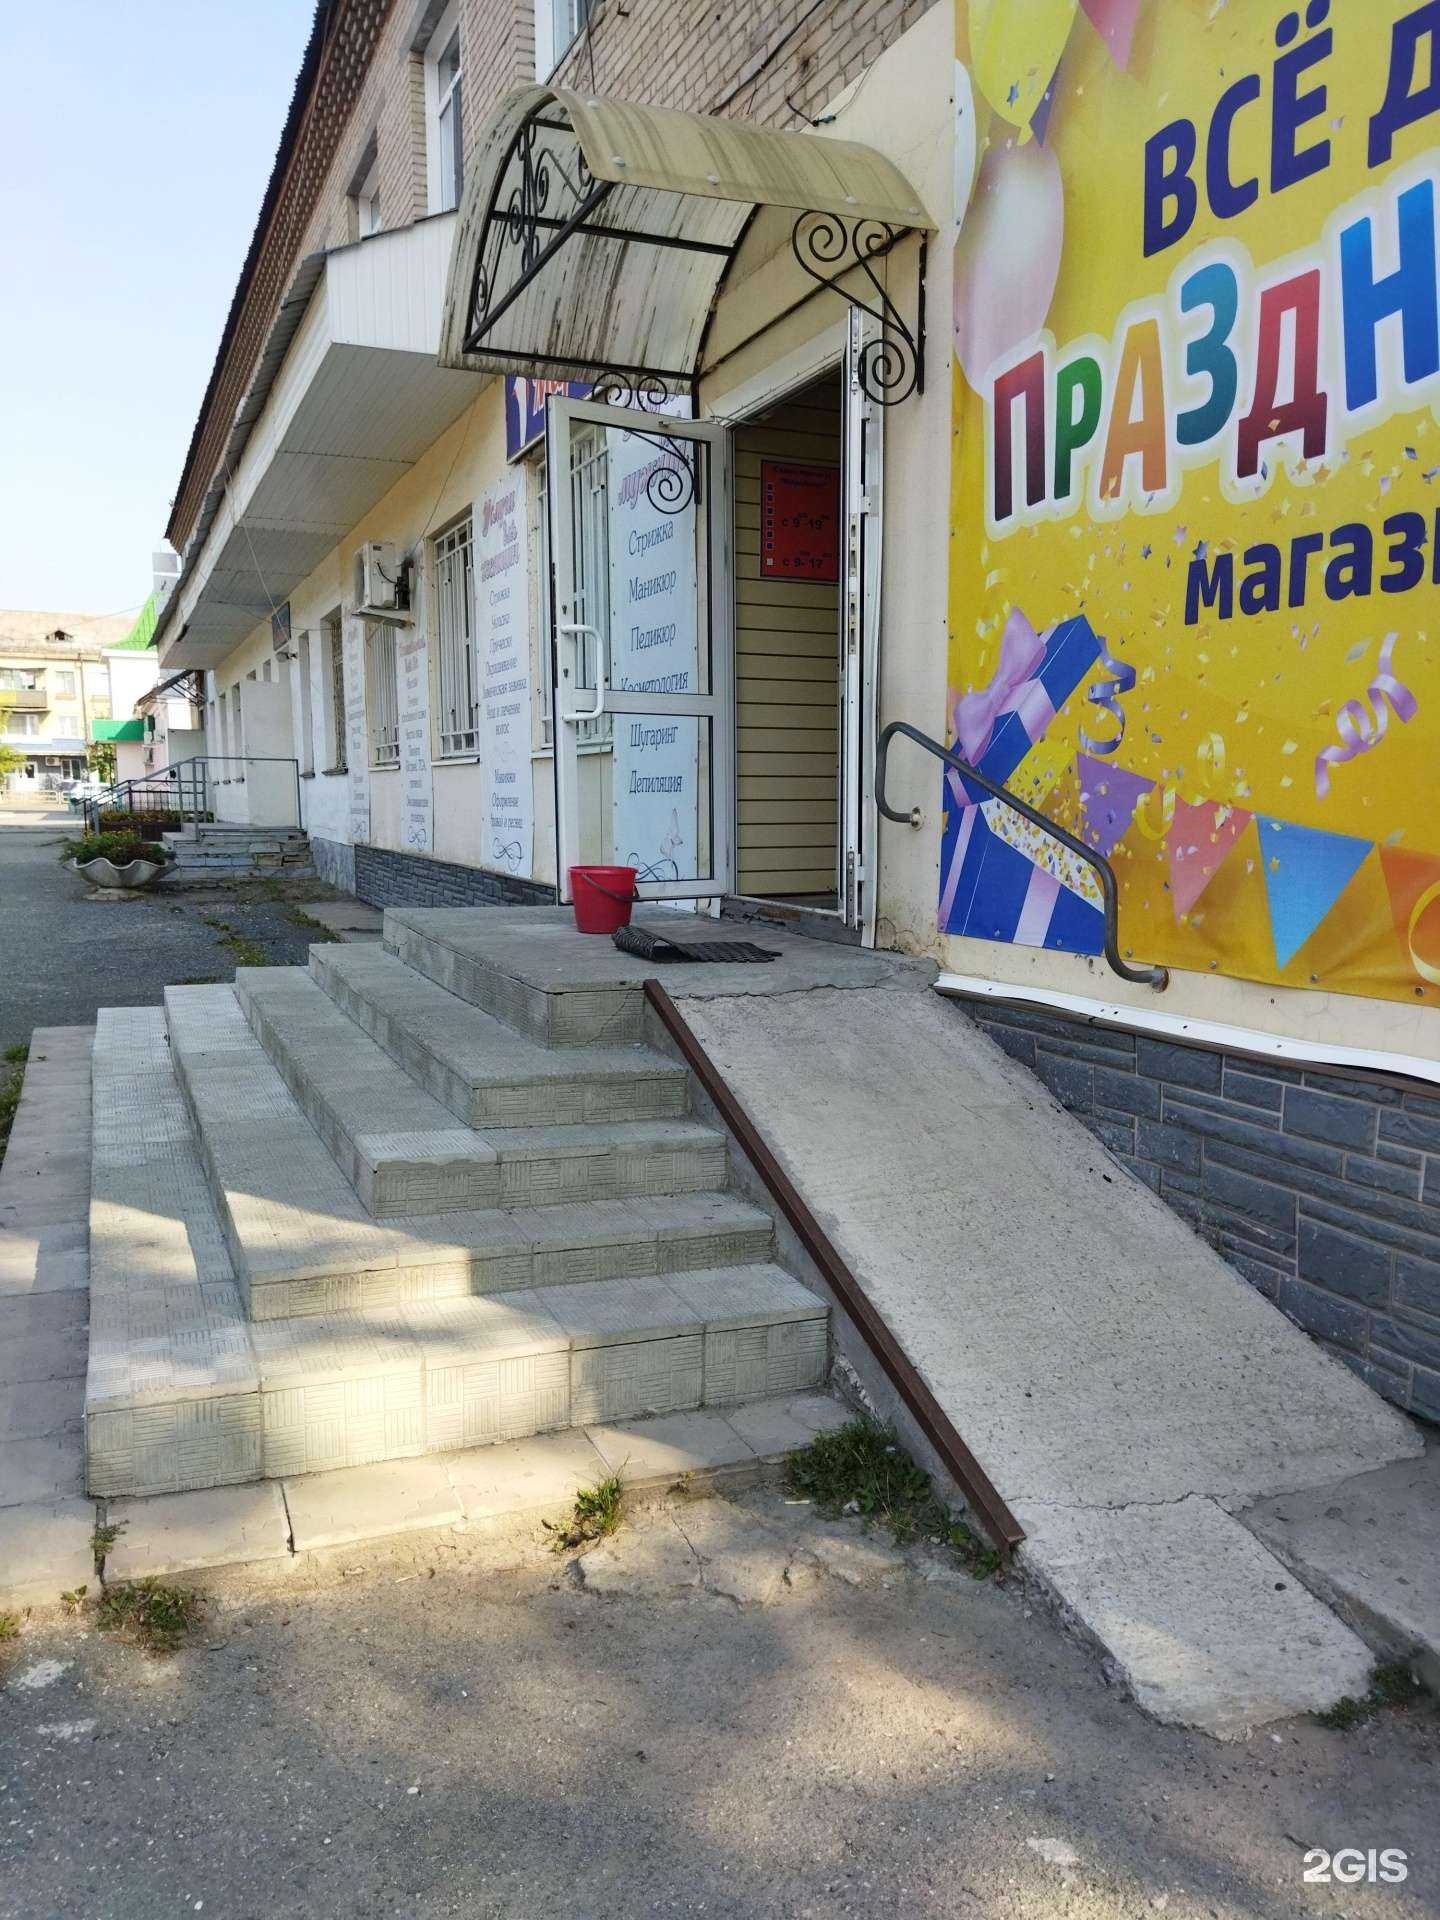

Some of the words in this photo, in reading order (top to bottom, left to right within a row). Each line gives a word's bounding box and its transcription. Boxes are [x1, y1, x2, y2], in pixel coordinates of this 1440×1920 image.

[1143, 0, 1333, 258] ВСЁ
[994, 178, 1440, 522] ПРАЗДН
[628, 520, 674, 556] Стрижка
[1185, 507, 1440, 626] магаз
[628, 570, 677, 603] Маникюр
[630, 623, 677, 651] Педикюр
[630, 723, 679, 752] Шугаринг
[629, 770, 683, 793] Депиляция
